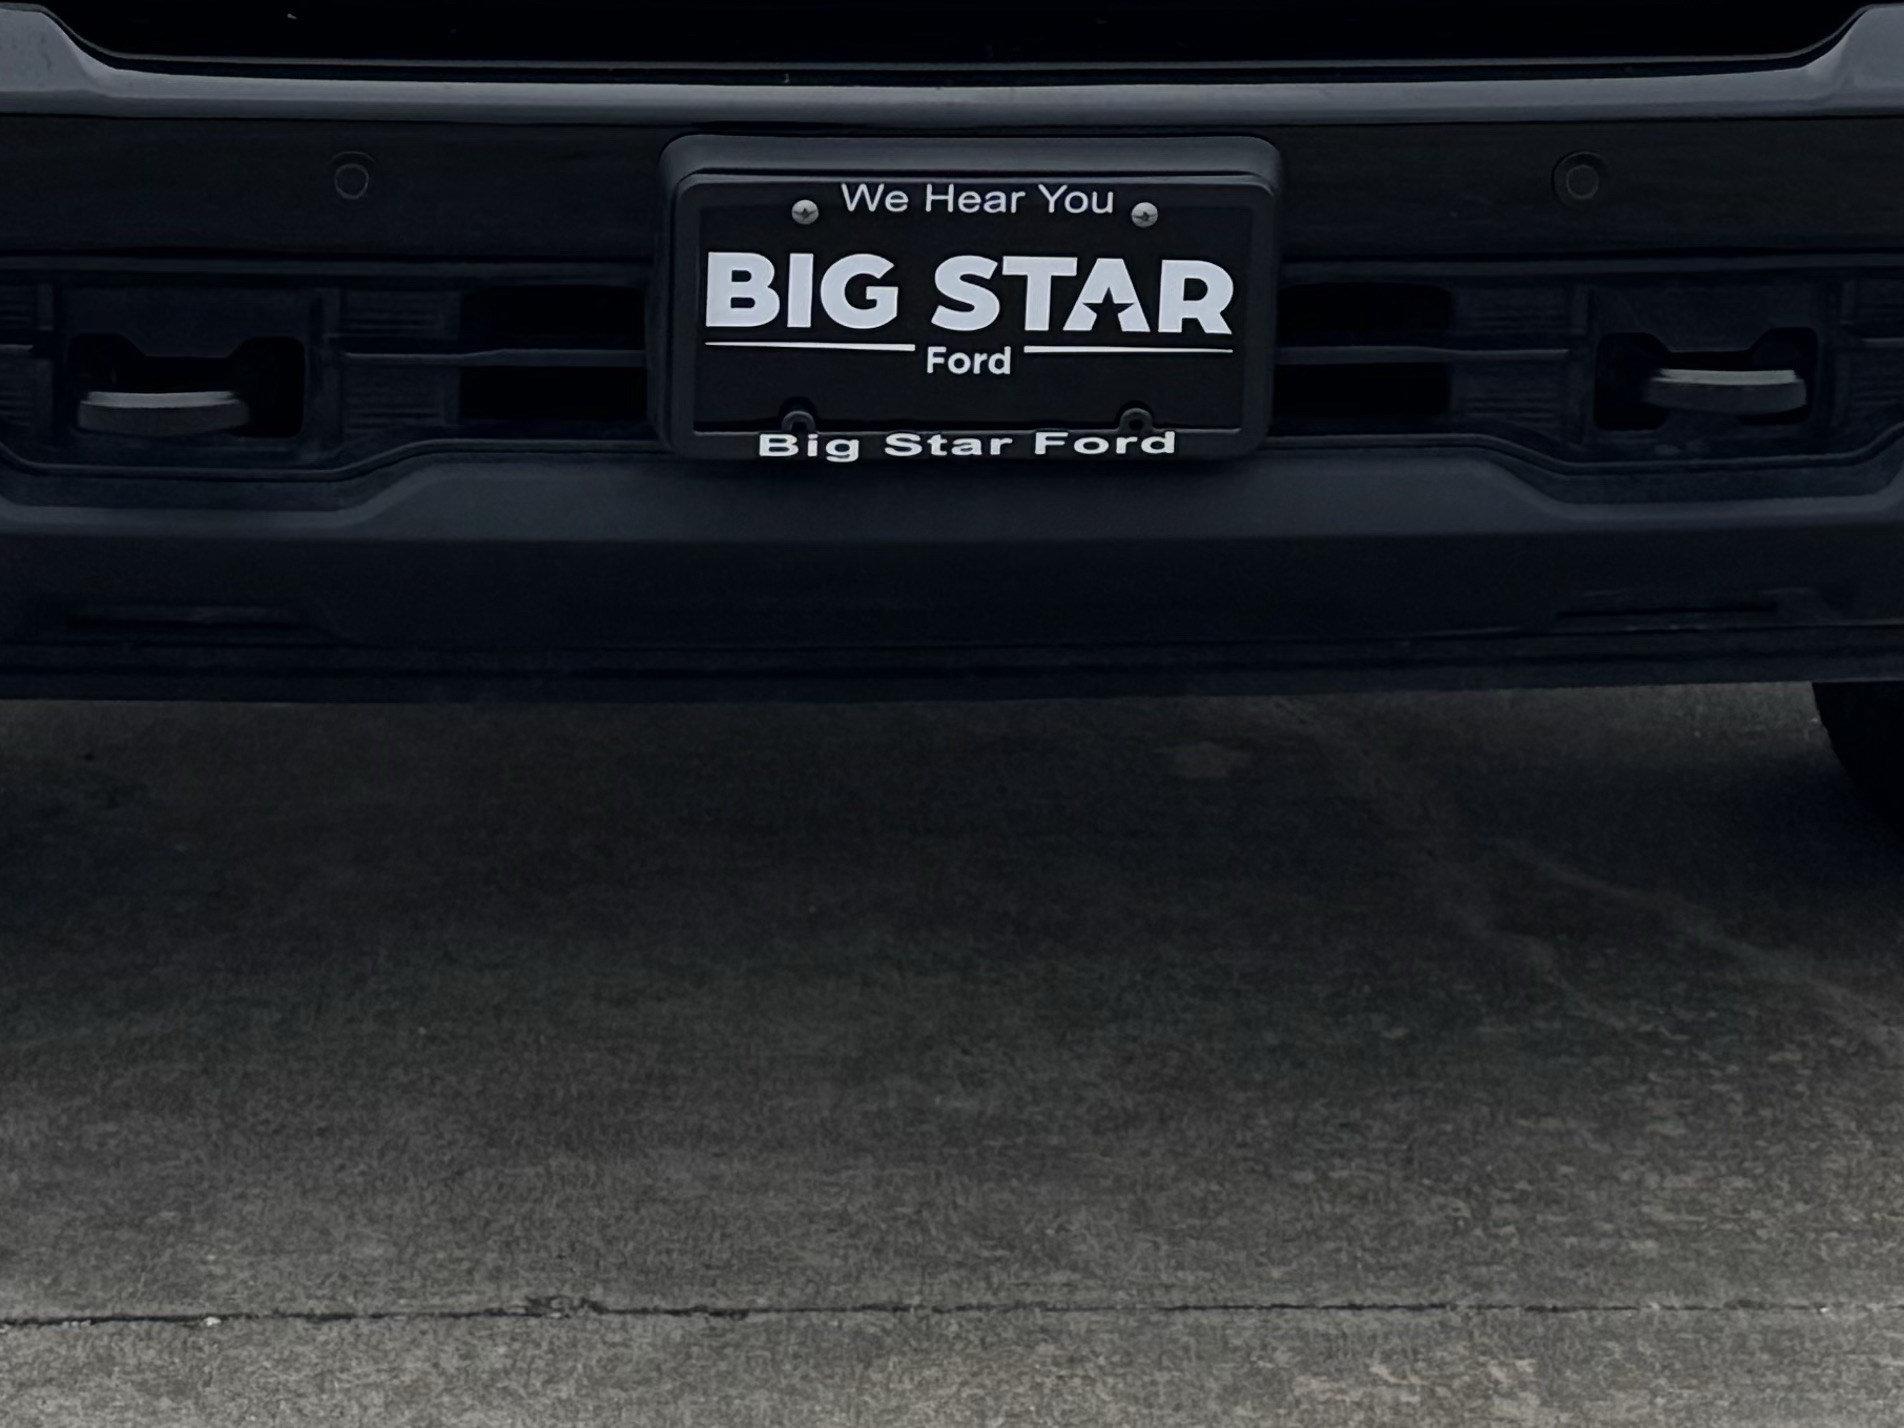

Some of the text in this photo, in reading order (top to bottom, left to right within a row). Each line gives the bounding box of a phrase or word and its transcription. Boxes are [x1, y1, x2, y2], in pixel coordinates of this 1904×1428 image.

[841, 183, 1114, 215] We Hear You
[706, 252, 1233, 335] BIG STAR
[927, 347, 1011, 375] Ford
[759, 431, 1176, 462] Big Star Ford
